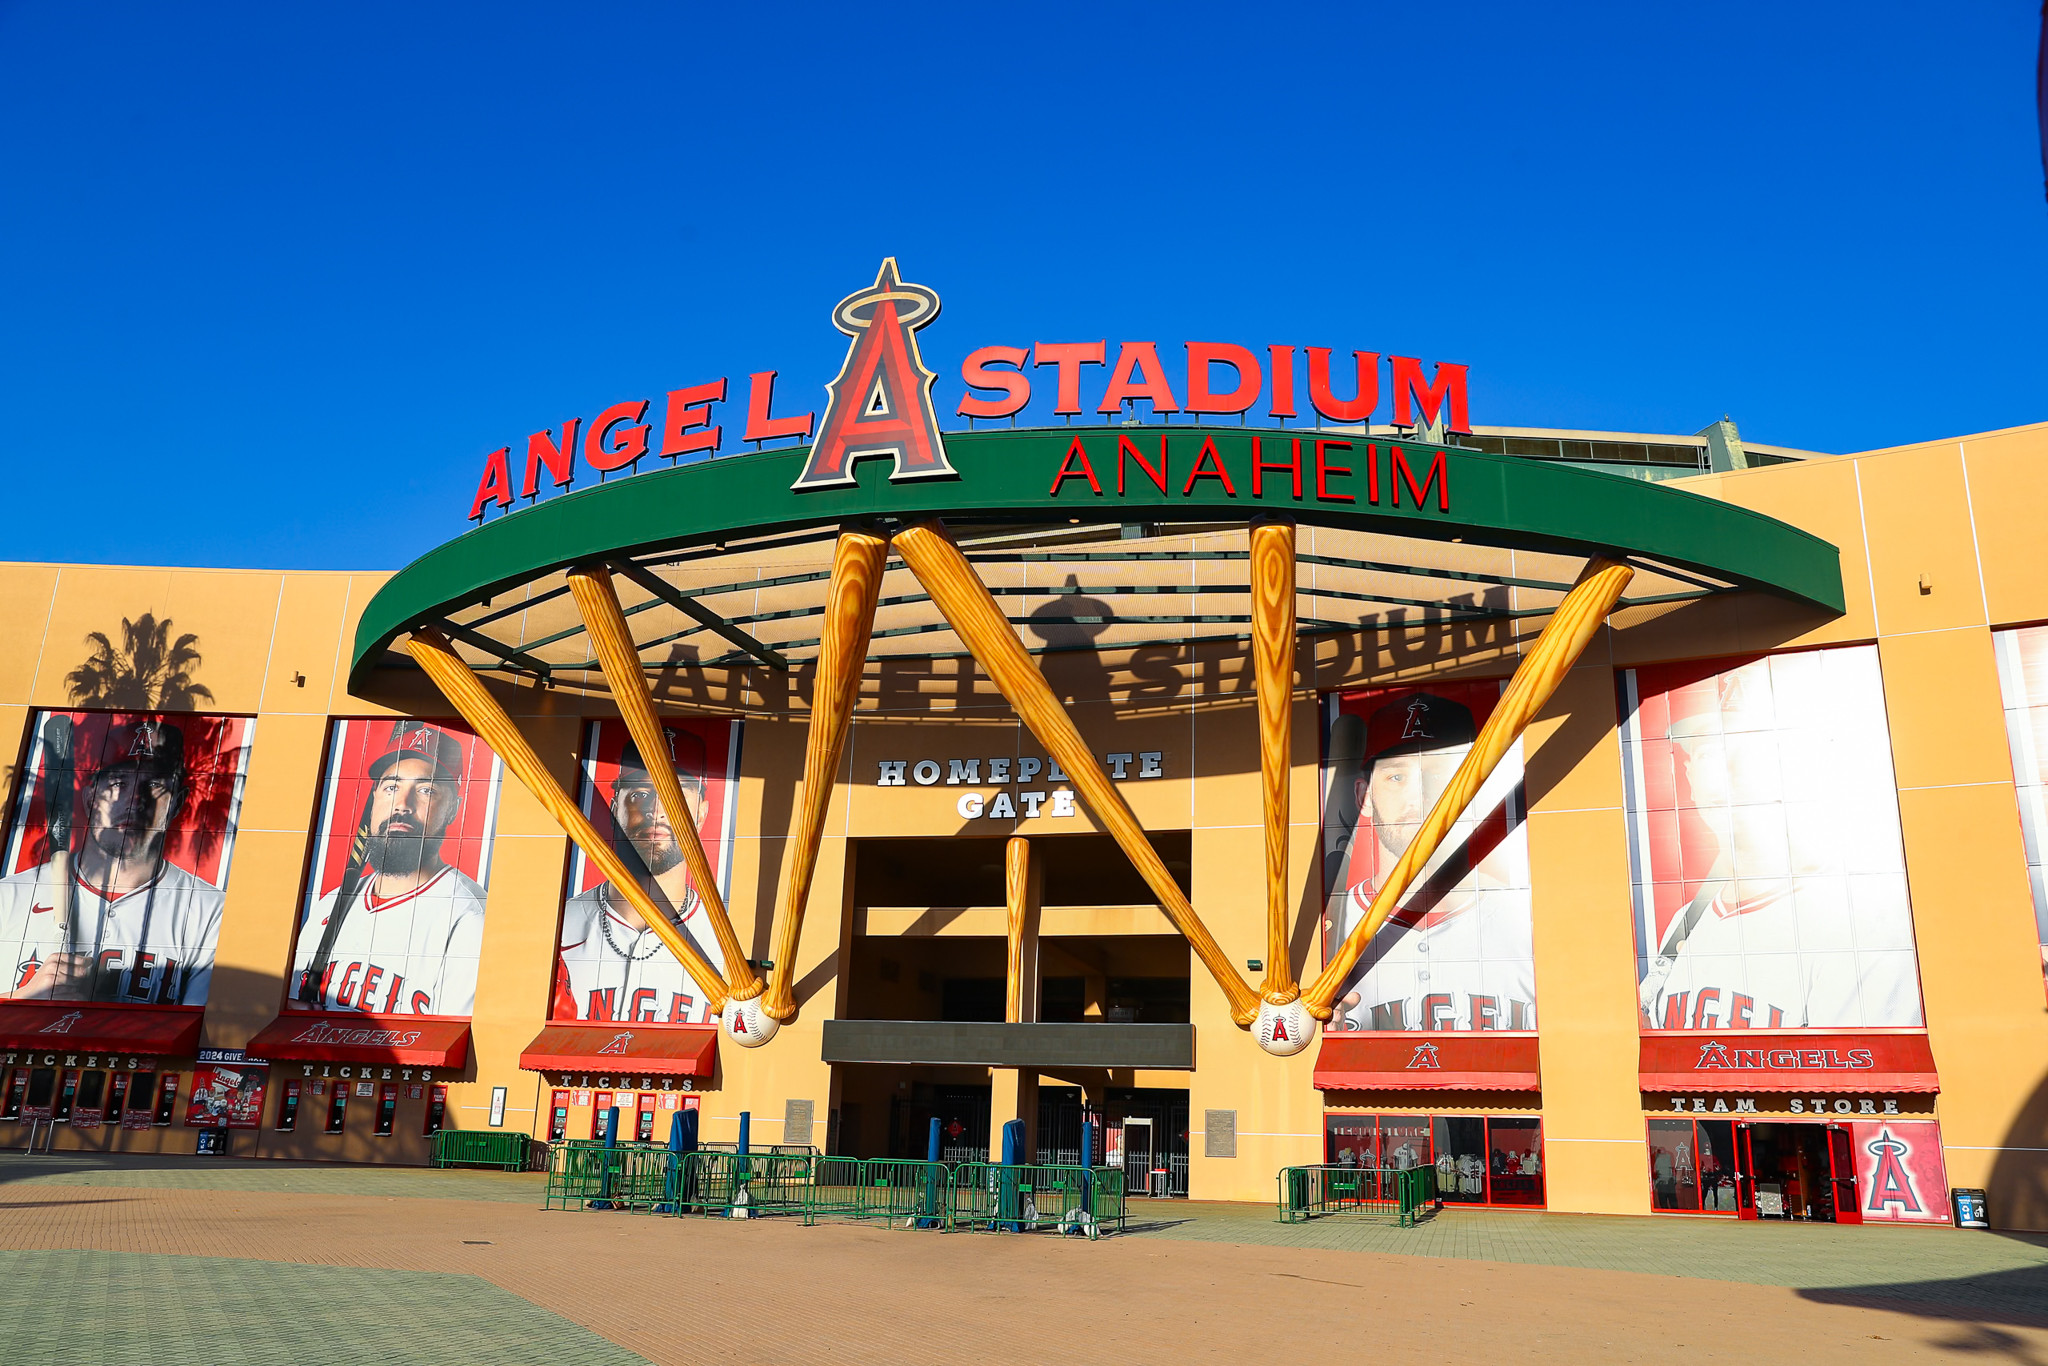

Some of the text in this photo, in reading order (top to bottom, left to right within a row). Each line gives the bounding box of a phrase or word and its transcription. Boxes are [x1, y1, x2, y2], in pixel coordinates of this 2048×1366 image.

[791, 256, 962, 493] A
[468, 338, 1473, 521] ANGEL STADIUM
[1049, 434, 1450, 513] ANAHEIM
[877, 751, 1163, 787] HOMEPLTE
[956, 790, 1076, 819] GATE
[291, 1020, 422, 1047] ANGELS
[6, 1053, 139, 1069] TICKETS
[200, 1050, 223, 1060] 2024
[1695, 1040, 1875, 1070] ANGELS
[303, 1064, 433, 1081] TICKETS
[560, 1074, 693, 1091] TICKETS
[1671, 1097, 1900, 1115] TEAM STORE
